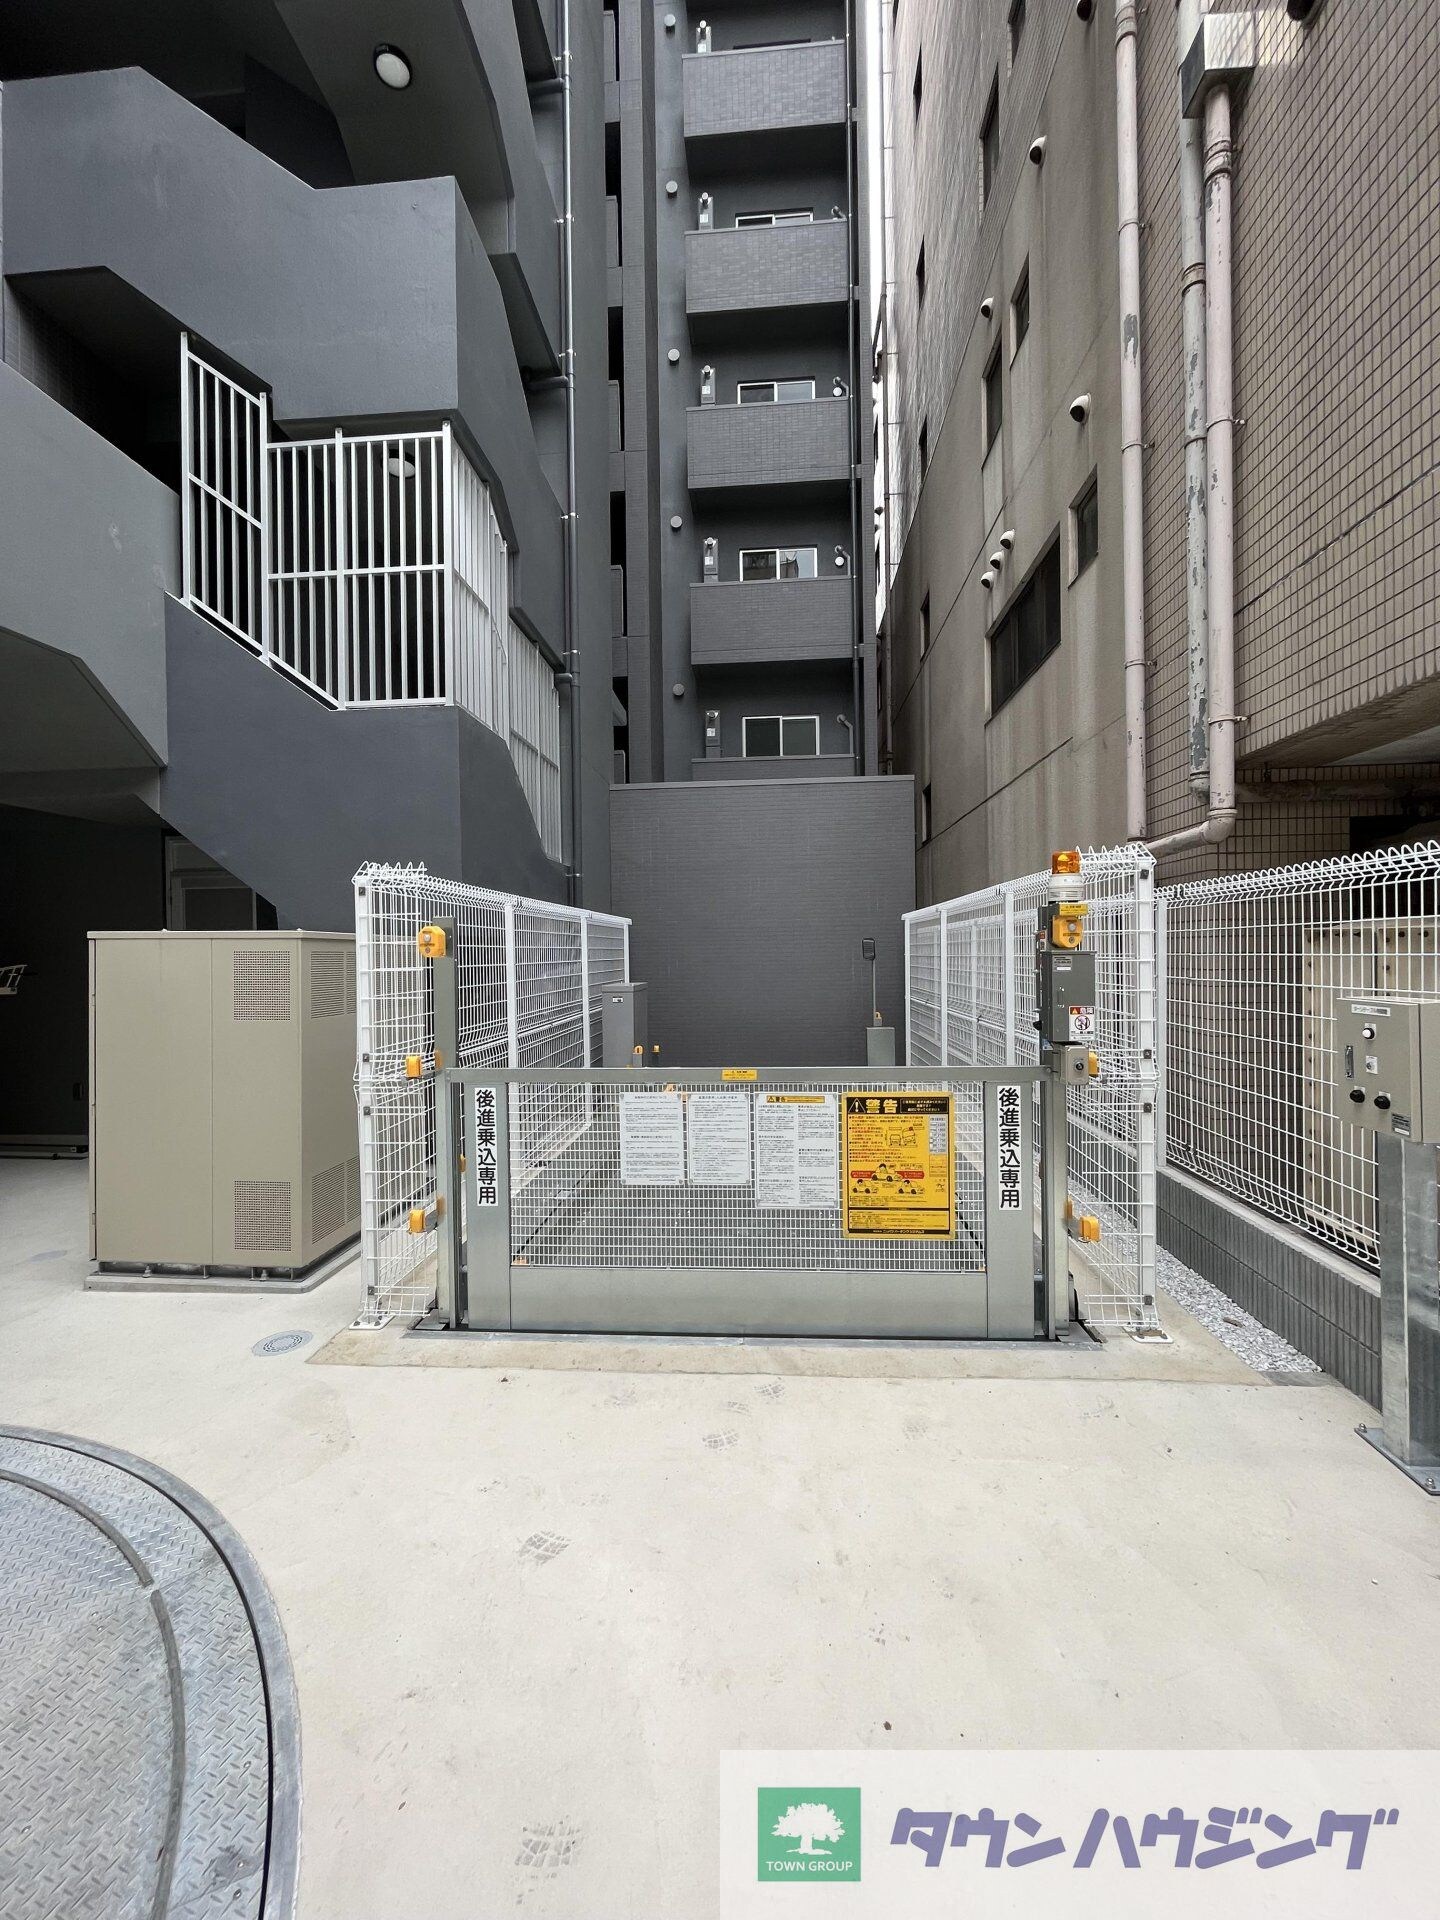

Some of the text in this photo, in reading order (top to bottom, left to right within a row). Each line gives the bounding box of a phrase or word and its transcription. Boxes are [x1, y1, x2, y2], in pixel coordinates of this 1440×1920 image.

[476, 1089, 496, 1204] 後進乗込専用
[865, 1098, 898, 1114] 警告
[999, 1087, 1020, 1208] 後進乗込専用
